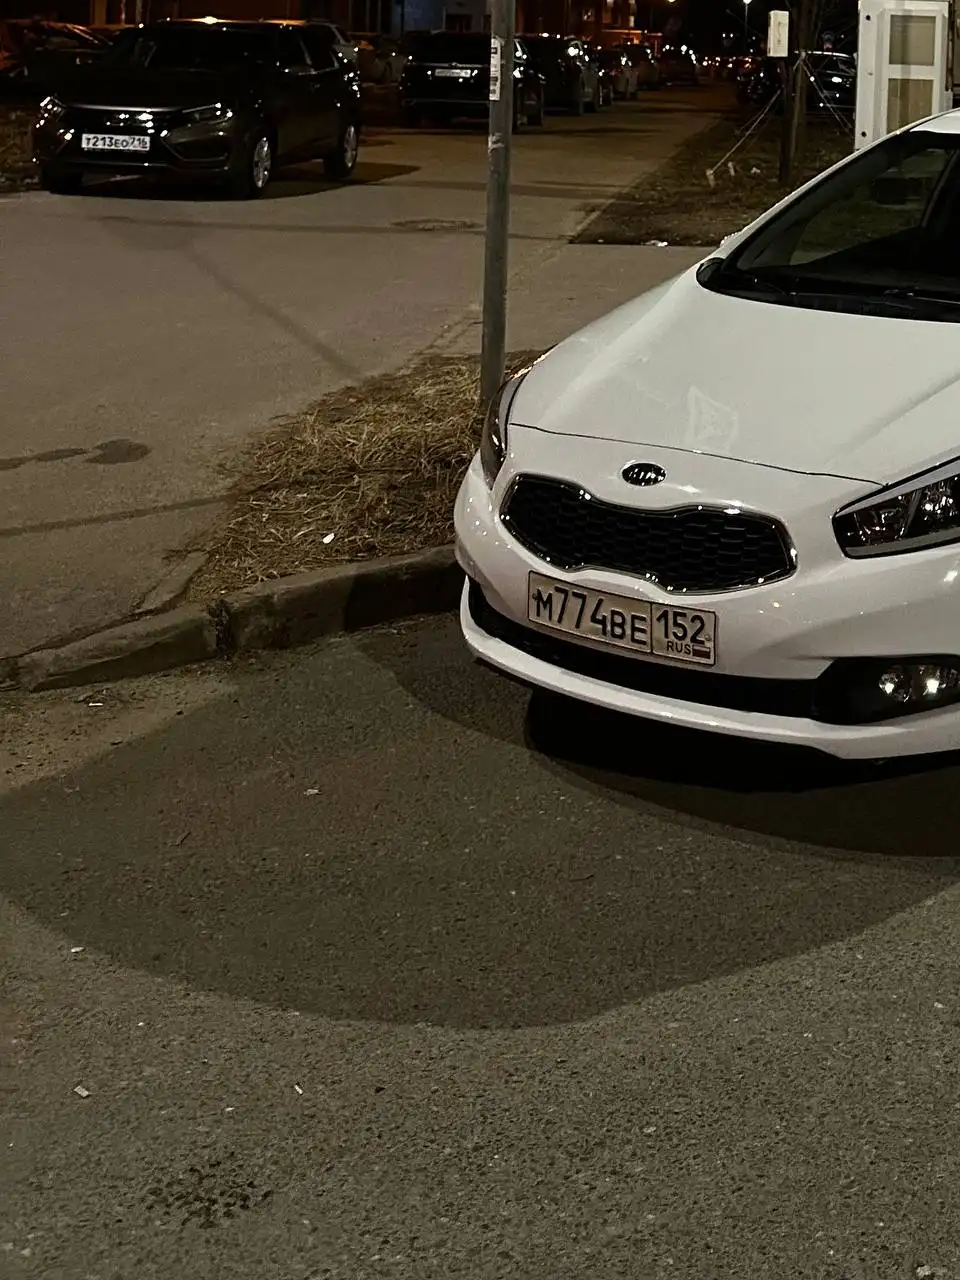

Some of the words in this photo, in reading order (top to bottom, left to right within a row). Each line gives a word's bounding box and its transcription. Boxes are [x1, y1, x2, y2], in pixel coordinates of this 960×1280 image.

[535, 586, 648, 646] М774ВЕ
[656, 609, 705, 645] 152
[667, 640, 691, 655] RUS
